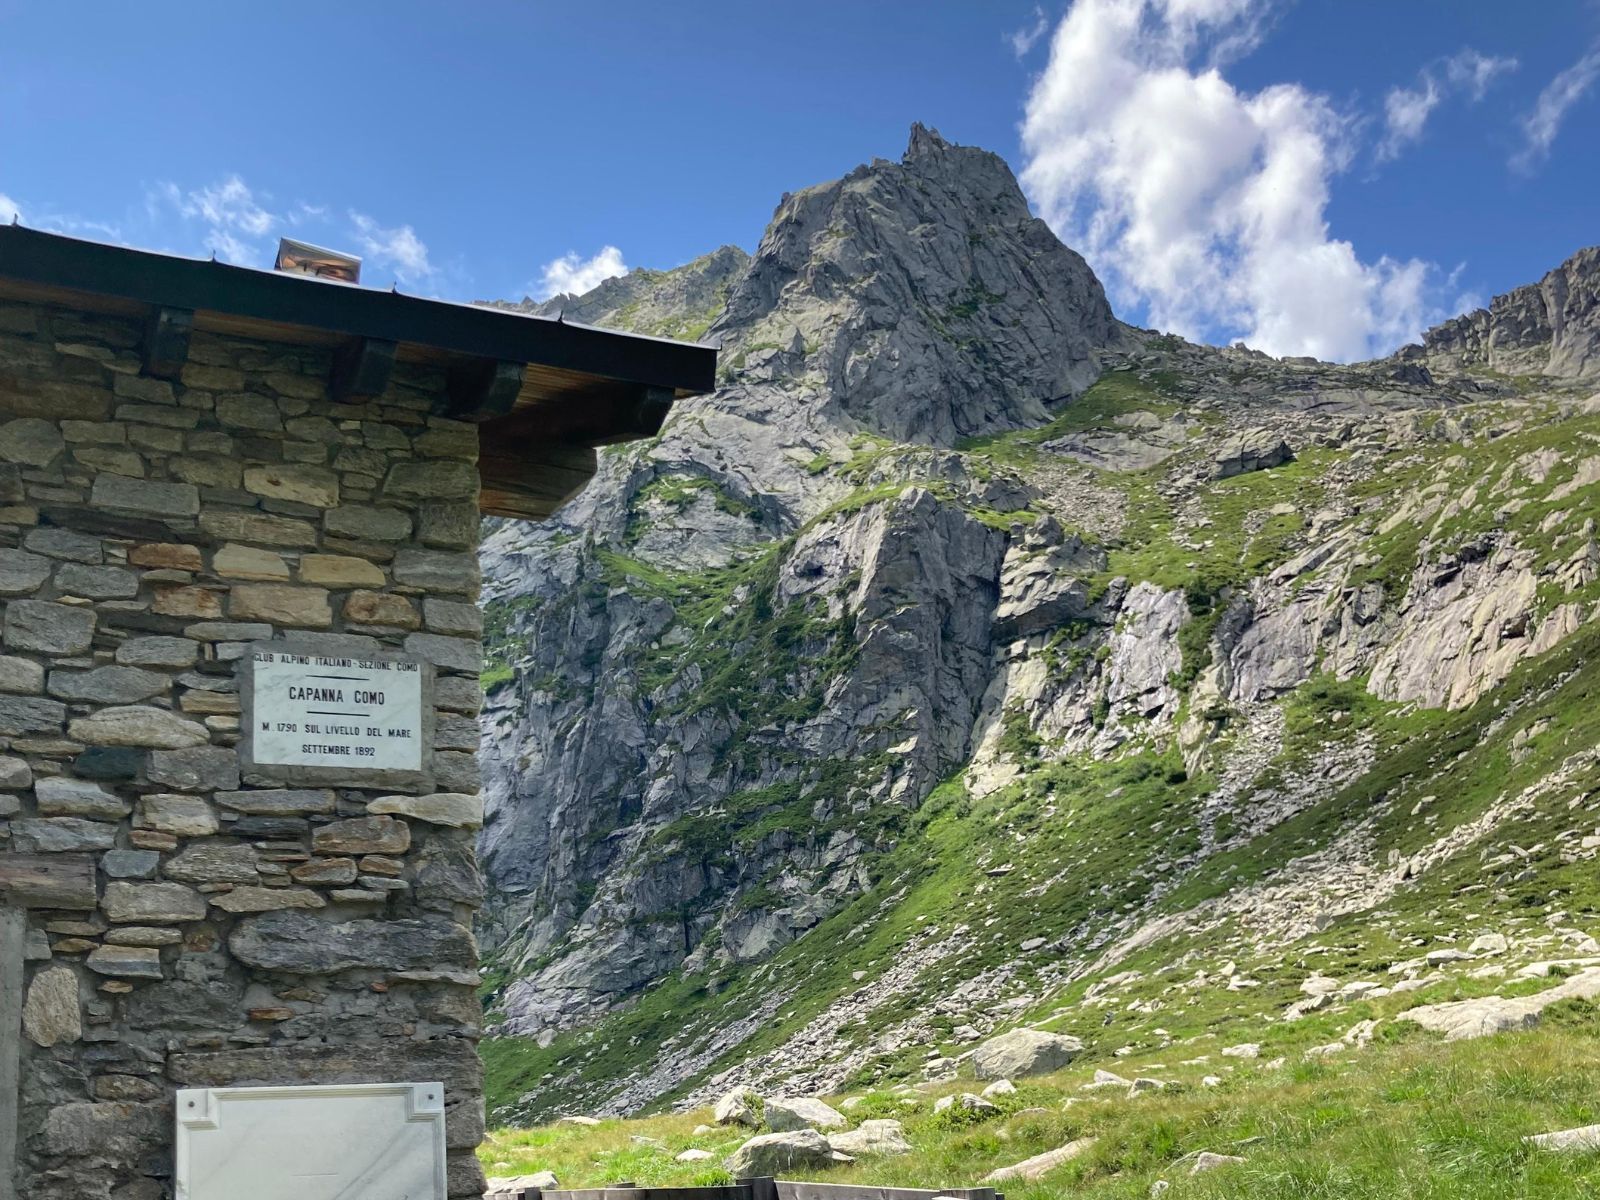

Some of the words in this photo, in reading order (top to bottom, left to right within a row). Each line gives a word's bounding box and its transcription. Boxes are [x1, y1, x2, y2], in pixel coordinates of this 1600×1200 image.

[281, 654, 310, 665] ALPINO
[397, 662, 418, 672] COMO
[289, 687, 344, 703] CAPANNA
[354, 690, 385, 705] COMO
[277, 723, 298, 733] 1790
[305, 724, 321, 734] SUL
[326, 725, 360, 736] LIVELLO
[367, 727, 383, 737] DEL
[388, 729, 412, 739] MARE
[302, 744, 351, 755] SETTEMBRE
[355, 746, 376, 757] 1892
